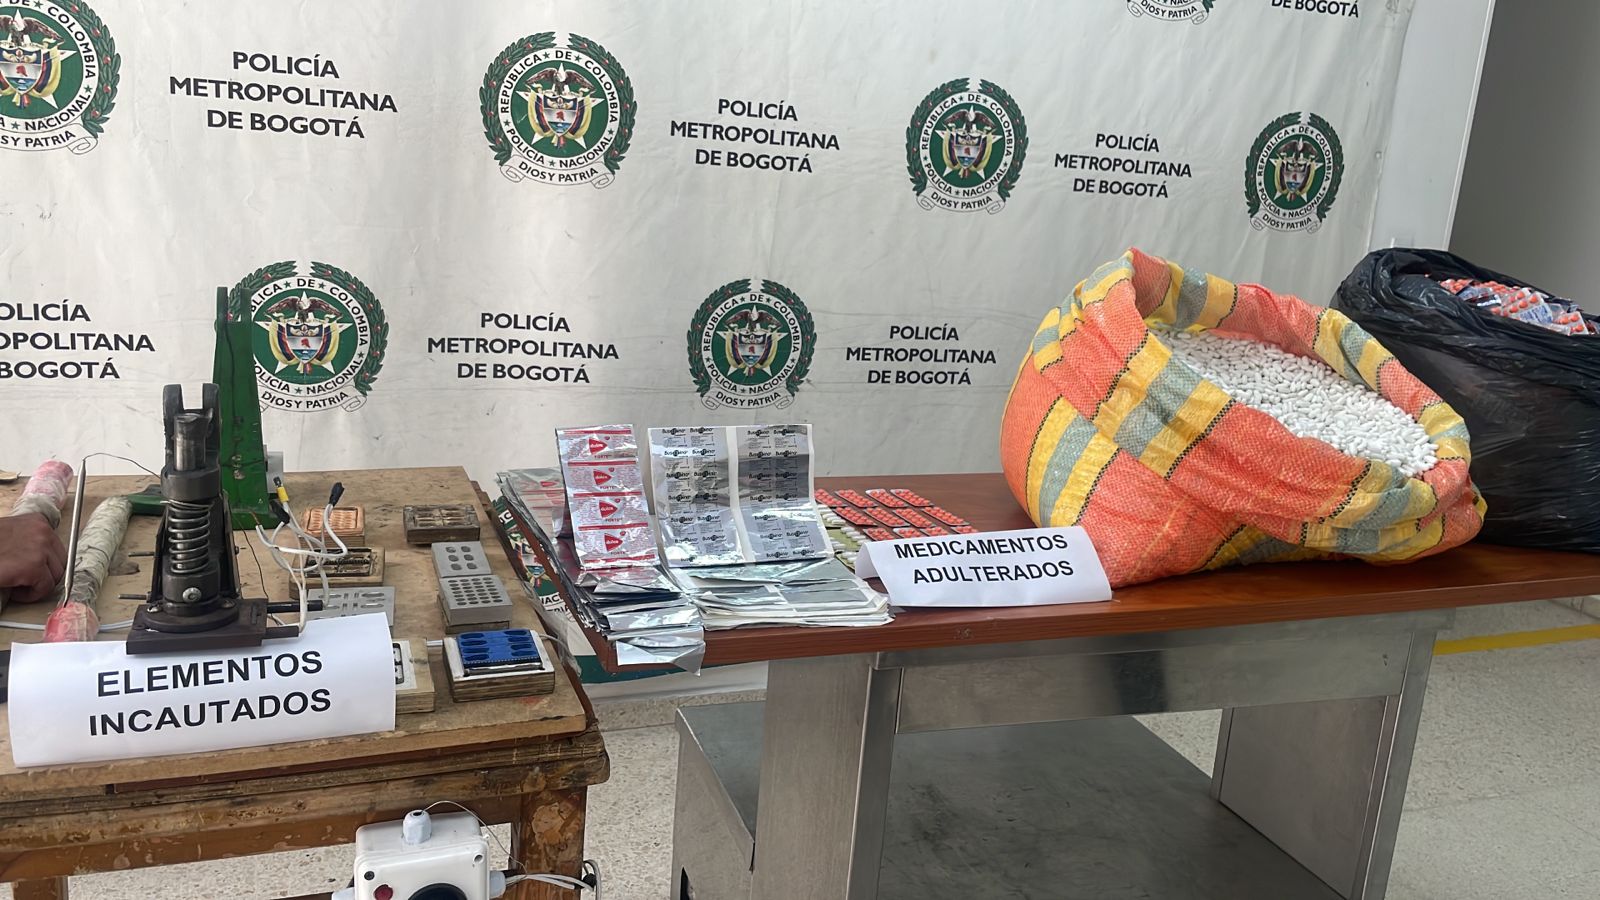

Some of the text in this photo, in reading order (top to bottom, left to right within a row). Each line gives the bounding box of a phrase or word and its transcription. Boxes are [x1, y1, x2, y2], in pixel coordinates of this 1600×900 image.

[1168, 6, 1197, 18] PATRIA
[1295, 0, 1359, 18] BOGOTÁ
[48, 6, 96, 79] COLOMBIA
[232, 51, 340, 78] POLICÍA
[169, 77, 398, 112] METROPOLITANA
[555, 50, 572, 60] DE
[585, 60, 619, 123] COLOMBIA
[25, 94, 91, 131] NACIONAL
[718, 99, 798, 121] POLICÍA
[207, 110, 365, 138] DE BOGOTÁ
[670, 121, 840, 150] METROPOLITANA
[967, 93, 981, 103] DE
[990, 103, 1013, 157] COLOMBIA
[11, 136, 21, 147] Y
[25, 130, 76, 147] PATRIA
[560, 133, 613, 168] NACIONAL
[1095, 133, 1160, 152] POLICÍA
[695, 149, 812, 173] DE BOGOTÁ
[1054, 153, 1192, 178] METROPOLITANA
[1298, 126, 1310, 134] DE
[1315, 133, 1332, 182] COLOMBIA
[519, 161, 547, 180] DIOS
[558, 167, 599, 182] PATRIA
[962, 168, 1007, 197] NACIONAL
[1073, 178, 1168, 198] DE BOGOTÁ
[961, 196, 993, 209] PATRIA
[1288, 192, 1326, 218] NACIONAL
[1286, 217, 1312, 229] PATRIA
[0, 299, 91, 322] OLICÍA
[250, 278, 369, 346] BLICA DE COLOMBIA
[481, 312, 570, 333] POLICÍA
[749, 293, 764, 302] DE
[774, 300, 800, 353] COLOMBIA
[889, 323, 959, 341] POLICÍA
[0, 332, 156, 352] POLITANA
[427, 337, 619, 359] METROPOLITANA
[846, 347, 997, 364] METROPOLITANA
[0, 358, 120, 379] BOGOTÁ
[306, 359, 363, 395] NACIONAL
[457, 363, 590, 383] DE BOGOTÁ
[749, 364, 794, 394] NACIONAL
[867, 368, 971, 385] DE BOGOTÁ
[261, 391, 293, 408] DIOS
[306, 391, 349, 409] PATRIA
[747, 392, 781, 406] PATRIA
[894, 534, 1068, 559] MEDICAMENTOS
[913, 560, 1074, 584] ADULTERADOS
[97, 650, 323, 697] ELEMENTOS
[89, 688, 331, 737] INCAUTADOS
